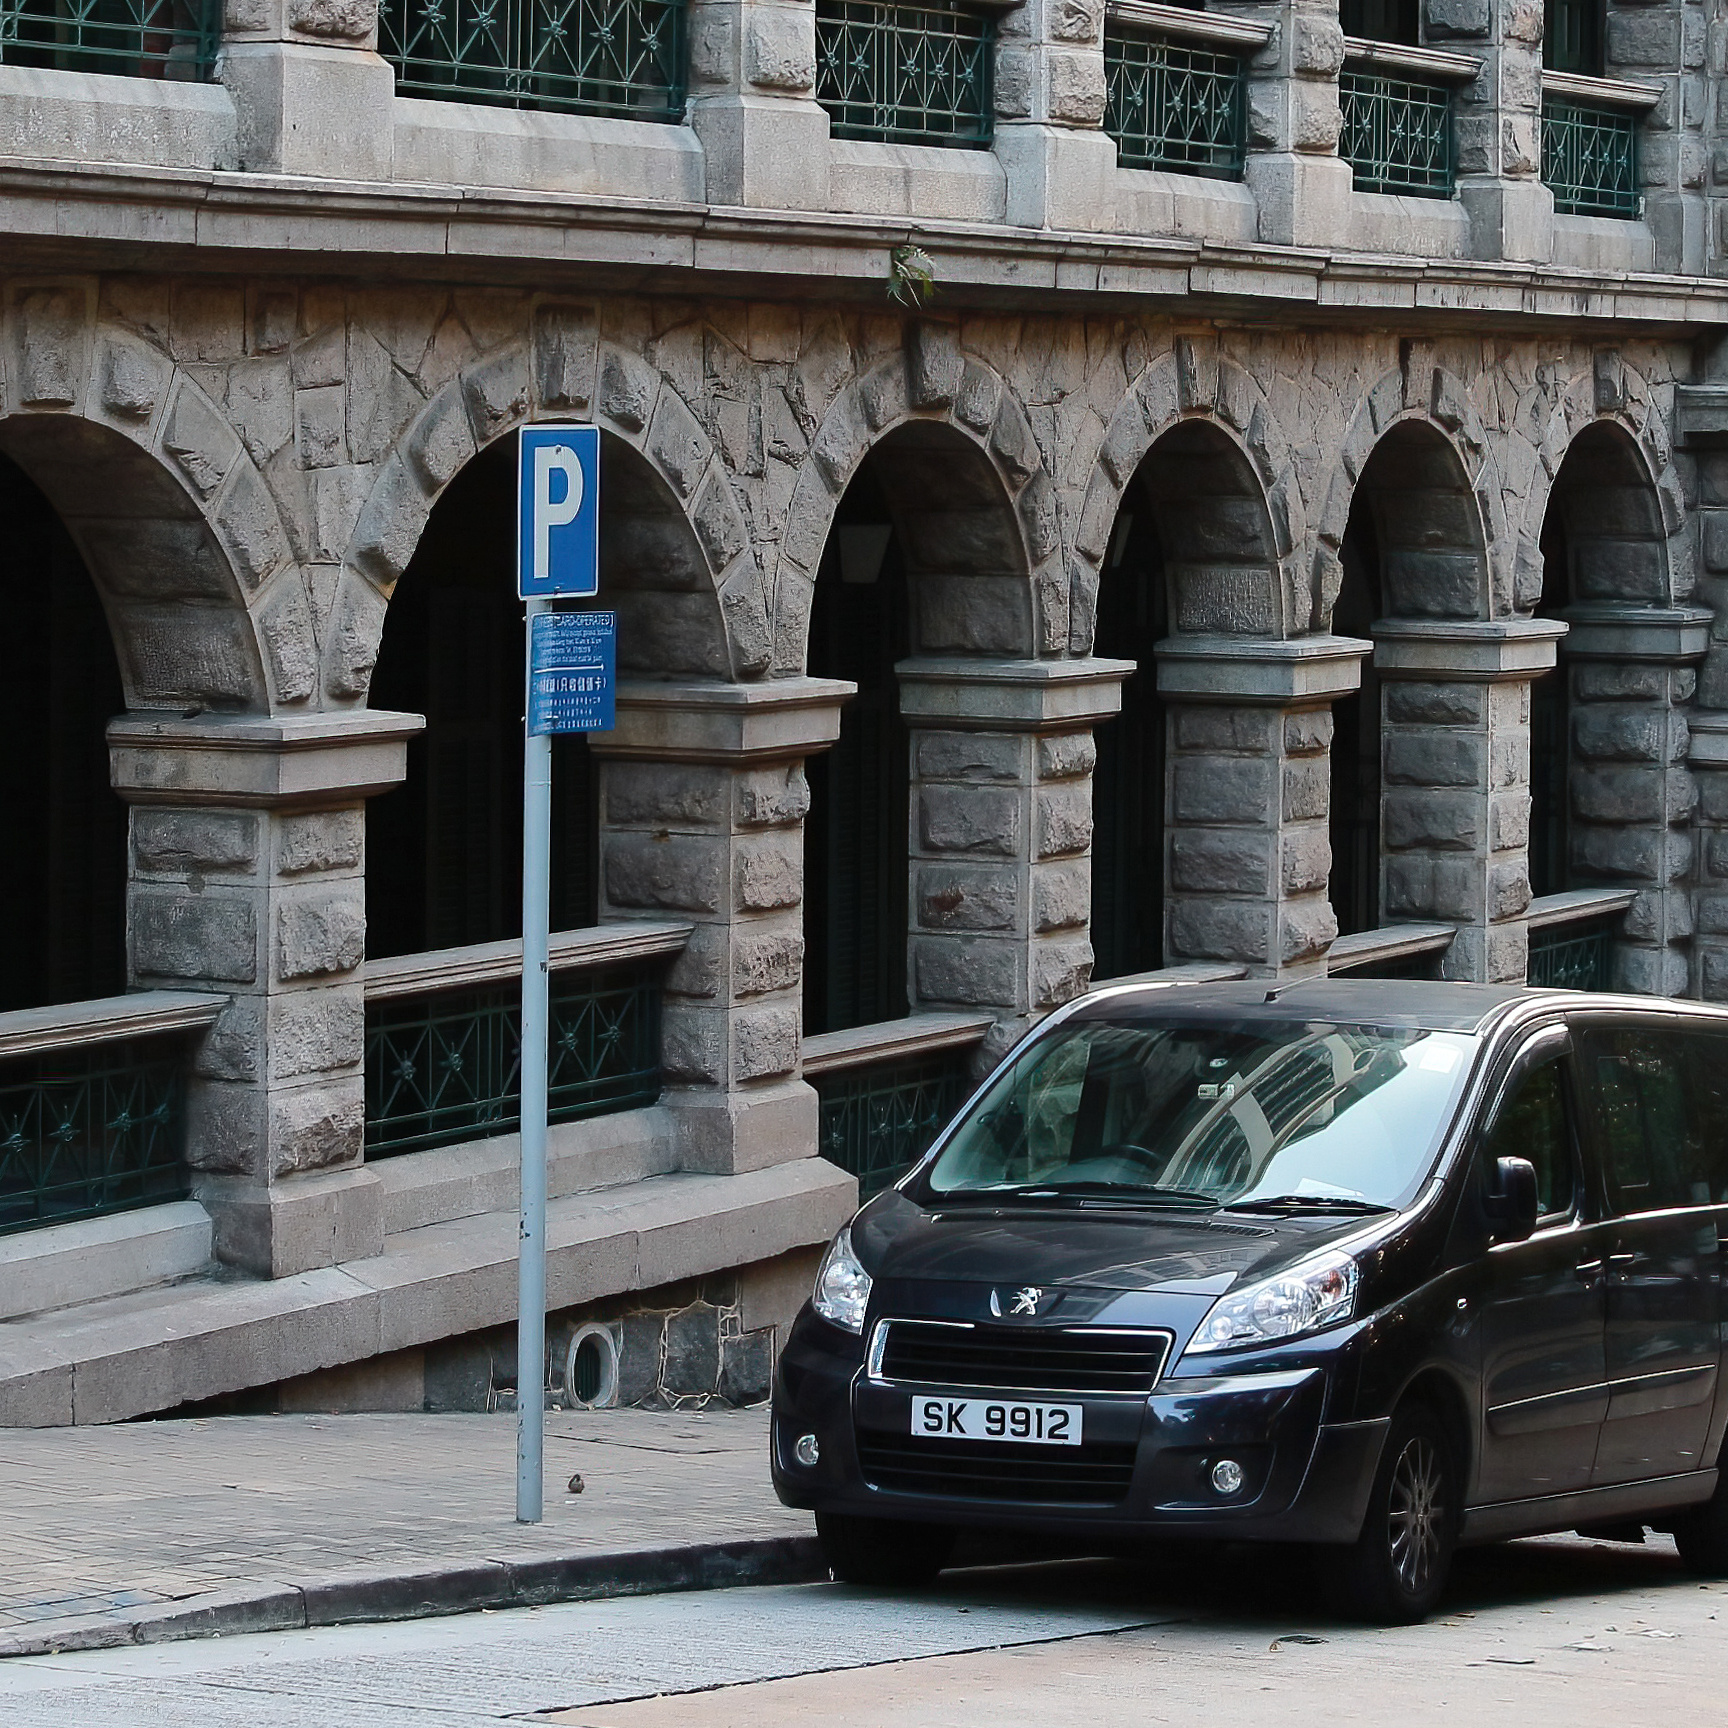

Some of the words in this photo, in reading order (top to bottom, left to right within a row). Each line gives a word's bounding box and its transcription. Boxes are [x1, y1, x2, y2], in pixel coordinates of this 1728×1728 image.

[534, 445, 583, 578] P
[923, 1401, 967, 1434] SK
[985, 1405, 1070, 1440] 9912
